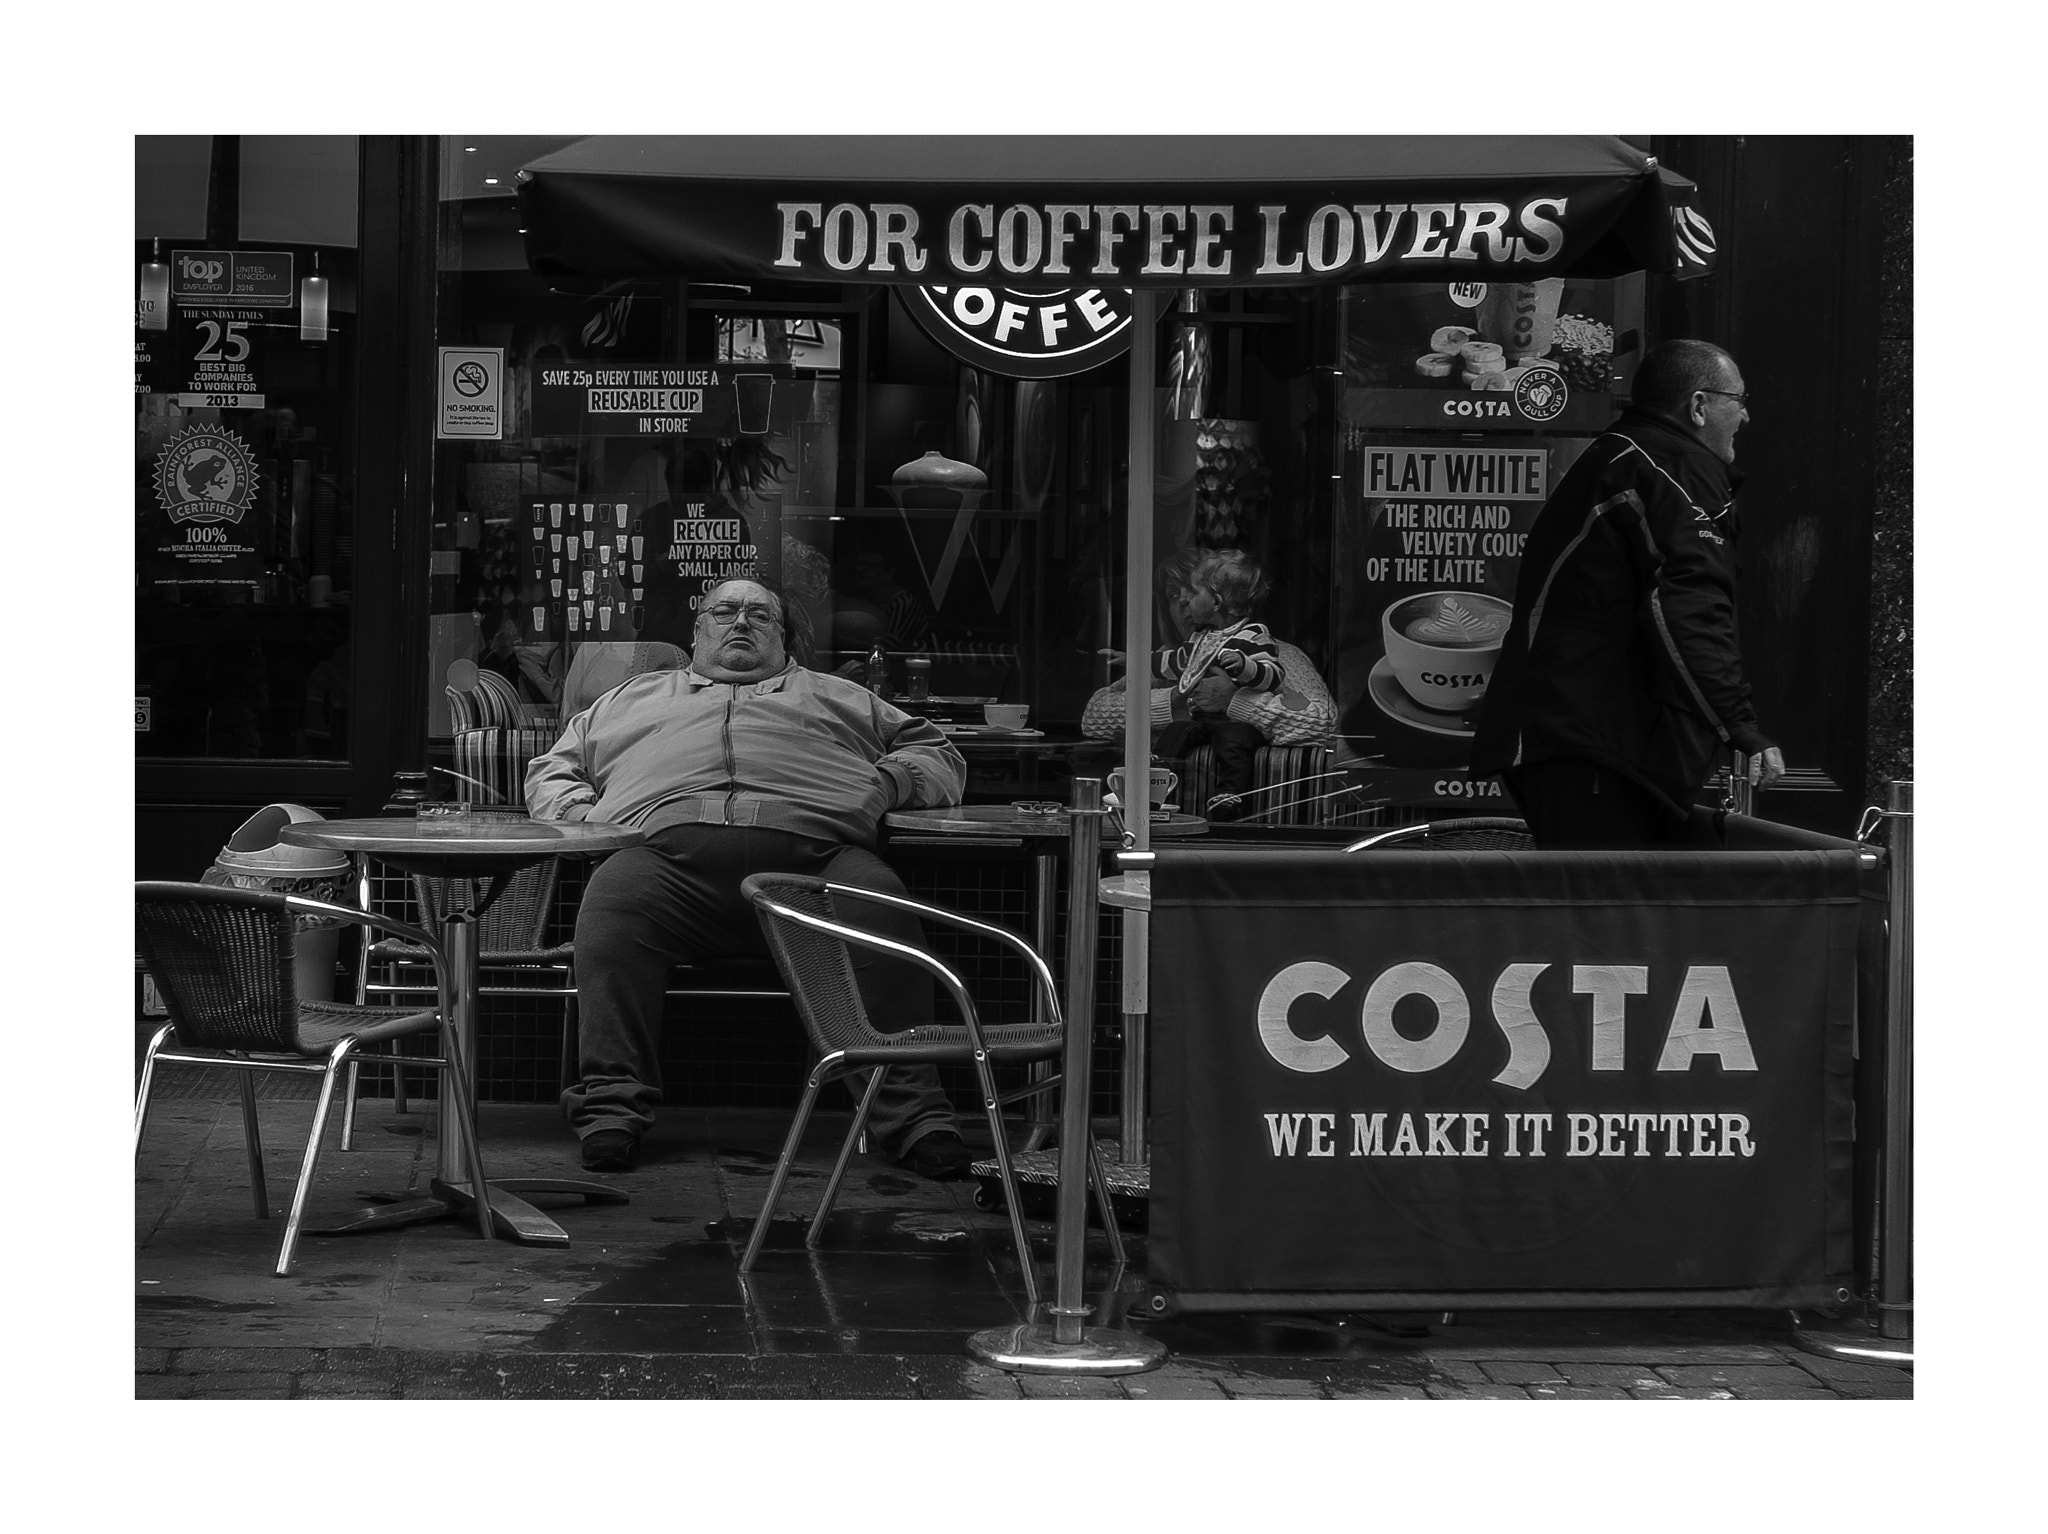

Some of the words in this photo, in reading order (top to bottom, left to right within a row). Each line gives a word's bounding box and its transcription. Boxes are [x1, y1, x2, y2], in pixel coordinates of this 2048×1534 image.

[773, 202, 928, 273] FOR
[948, 202, 1234, 277] COFFEE
[1255, 197, 1568, 277] LOVERS
[178, 255, 223, 283] top
[235, 266, 265, 274] UNITED
[235, 272, 276, 281] KINGDOM
[182, 283, 223, 291] EMPLOYER
[1453, 281, 1483, 300] NEW
[182, 310, 198, 319] THE
[198, 310, 235, 320] SUNDAY
[238, 310, 264, 320] TIMES
[932, 286, 1132, 347] OFFE
[194, 320, 250, 362] 25
[200, 362, 226, 372] BEST
[228, 362, 246, 372] BIG
[194, 372, 254, 382] COMPANIES
[542, 371, 570, 386] SAVE
[572, 371, 593, 389] 25p
[595, 371, 630, 386] EVERY
[632, 371, 660, 386] TIME
[661, 371, 685, 386] YOU
[687, 371, 708, 386] USE
[710, 371, 720, 386] A
[1518, 372, 1548, 394] NEVER
[1548, 377, 1556, 385] A
[188, 382, 202, 391] TO
[203, 382, 235, 392] WORK
[236, 382, 257, 392] FOR
[206, 395, 239, 407] 2013
[459, 404, 496, 413] SMOKING.
[591, 391, 666, 411] REUSABLE
[668, 391, 700, 411] CUP
[1443, 400, 1512, 418] COSTA
[1524, 404, 1549, 417] DULL
[1550, 394, 1564, 412] CUP
[639, 418, 651, 433] IN
[168, 438, 213, 488] RAINFOREST
[215, 440, 245, 488] ALLIANCE
[1370, 453, 1438, 492] FLAT
[1444, 454, 1541, 495] WHITE
[176, 502, 235, 517] CERTIFIED
[687, 504, 706, 518] WE
[1385, 504, 1420, 528] THE
[1423, 504, 1466, 528] RICH
[1470, 506, 1510, 530] AND
[185, 527, 227, 543] 100%
[676, 522, 737, 541] RECYCLE
[668, 545, 692, 560] ANY
[695, 545, 731, 560] PAPER
[734, 545, 759, 560] CUP.
[1401, 532, 1480, 556] VELVETY
[678, 562, 718, 580] SMALL,
[720, 562, 760, 580] LARGE,
[1366, 558, 1390, 582] OF
[1394, 558, 1428, 582] THE
[1433, 558, 1486, 583] LATTE
[1420, 672, 1484, 689] COSTA
[1150, 778, 1167, 786] OSTA
[1434, 780, 1502, 798] COSTA
[1257, 960, 1759, 1091] COSTA
[1264, 1112, 1335, 1158] WE
[1349, 1112, 1490, 1158] MAKE
[1504, 1112, 1552, 1158] IT
[1566, 1112, 1757, 1159] BETTER
